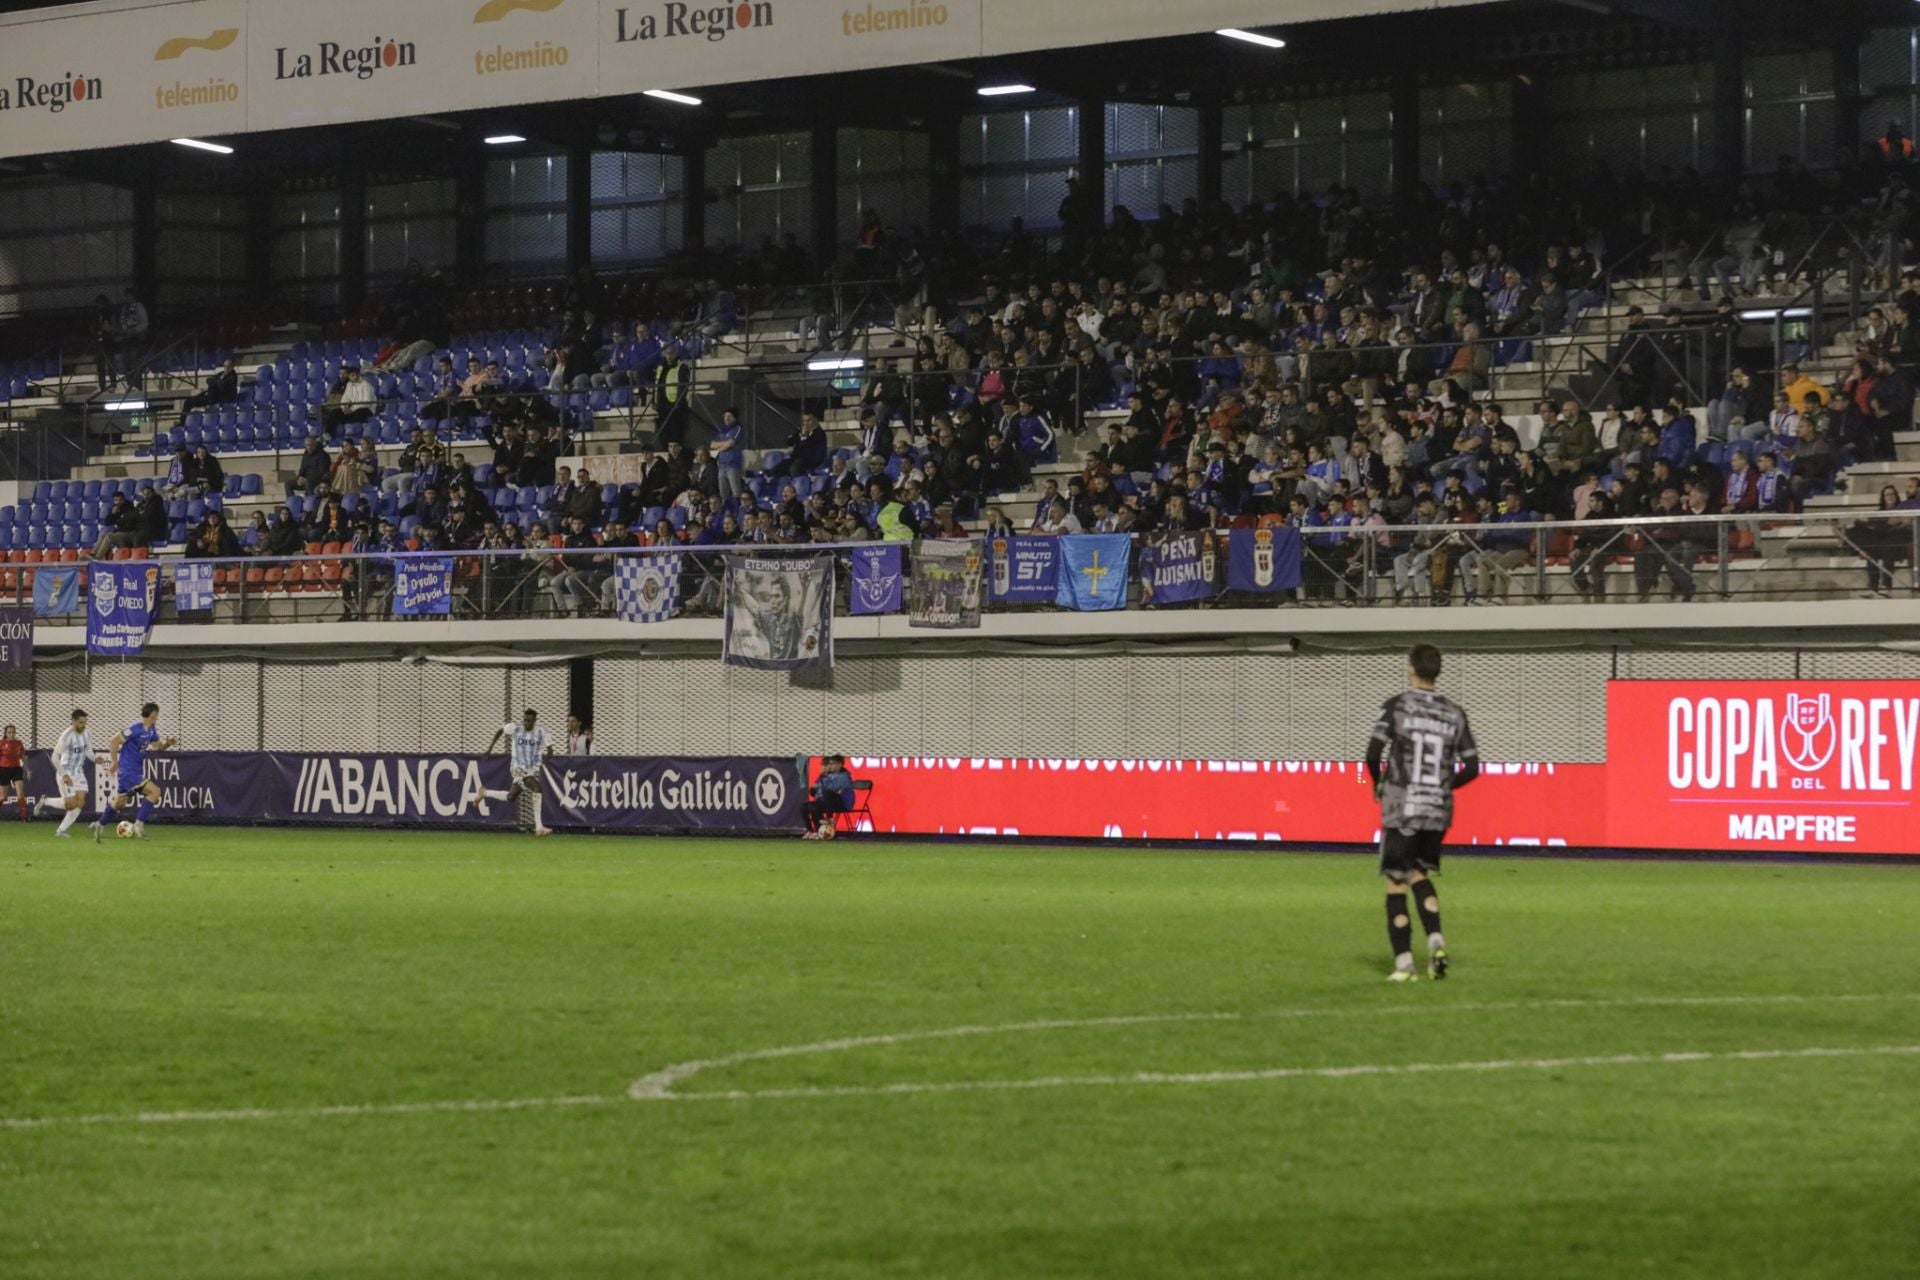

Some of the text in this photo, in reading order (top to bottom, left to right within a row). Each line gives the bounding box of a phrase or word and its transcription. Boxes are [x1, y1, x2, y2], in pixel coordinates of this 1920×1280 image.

[615, 0, 774, 43] La Región
[841, 0, 948, 36] telemiño
[275, 36, 417, 80] La Región
[474, 42, 569, 76] telemiño
[16, 71, 103, 113] Región
[155, 77, 239, 110] telemiño
[745, 559, 781, 571] ETERNO
[1016, 552, 1052, 560] MINUTO
[1161, 535, 1196, 561] PEÑA
[1411, 731, 1444, 785] 13
[1668, 697, 1920, 790] COPA REY
[559, 769, 749, 811] Estrella Galicia
[1791, 777, 1826, 790] DEL
[1728, 814, 1856, 842] MAPFRE
